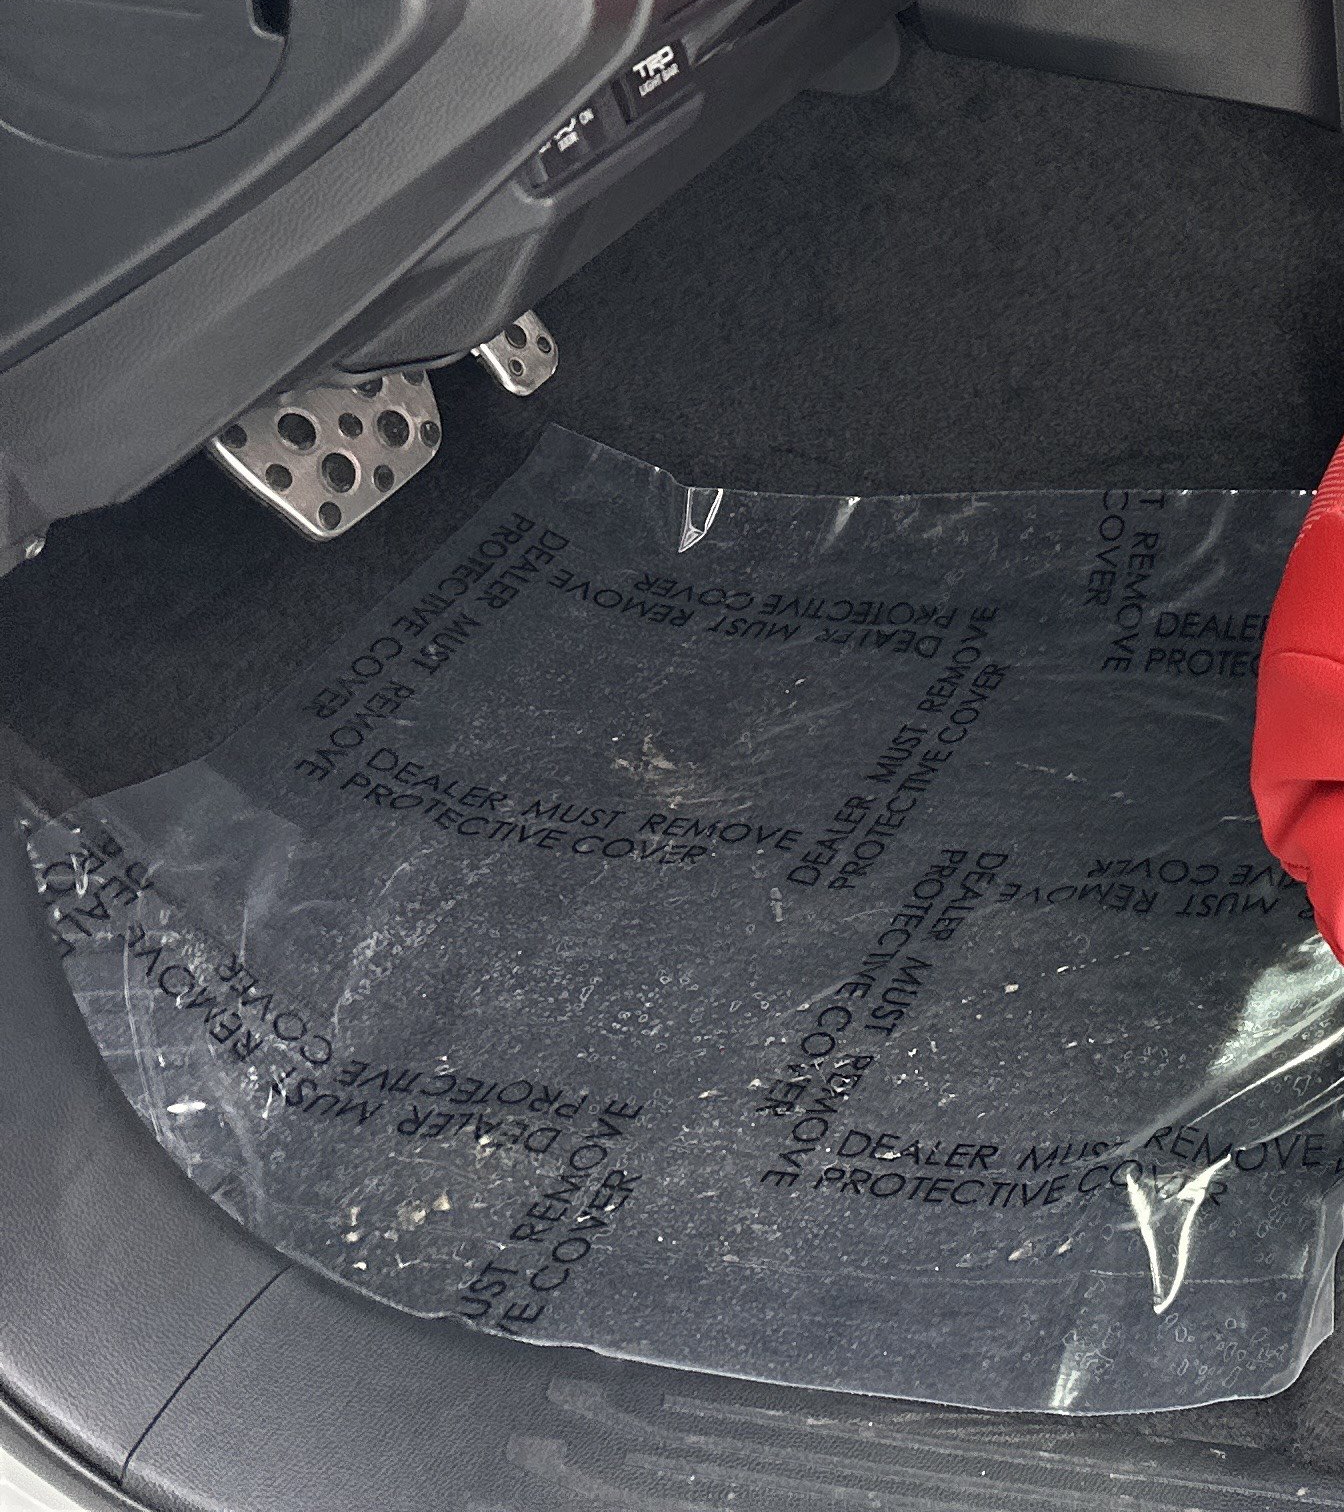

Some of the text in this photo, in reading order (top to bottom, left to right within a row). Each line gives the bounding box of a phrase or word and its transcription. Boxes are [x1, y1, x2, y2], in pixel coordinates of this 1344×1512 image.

[632, 45, 675, 78] TRD
[302, 512, 536, 720] PROTECTIVE COVER
[549, 568, 943, 659] DEALER MUST REMOVE
[632, 572, 958, 630] PROTECTIVE COVER
[1101, 531, 1159, 672] REMOVE
[294, 530, 570, 782] DEALER MUST REMOVE
[786, 606, 999, 887] DEALER MUST REMOVE
[827, 663, 1011, 889] PROTECTIVE COVER
[339, 771, 708, 866] PROTECTIVE COVER
[366, 747, 804, 852] DEALER MUST REMOVE
[928, 851, 1009, 941] DEALER
[996, 882, 1159, 915] REMOVE
[1088, 857, 1219, 885] COVER
[1176, 891, 1281, 918] MUST
[836, 849, 969, 999] PROTECTIVE
[216, 953, 588, 1119] PROTECTIVE COVER
[864, 955, 933, 1037] MUST
[816, 1160, 1229, 1208] PROTECTIVE COVR
[837, 1129, 999, 1172] DEALER
[1143, 1125, 1325, 1172] REMOVE
[460, 1261, 519, 1319] UST
[510, 1100, 643, 1242] REMOVE
[530, 1170, 643, 1291] COVER
